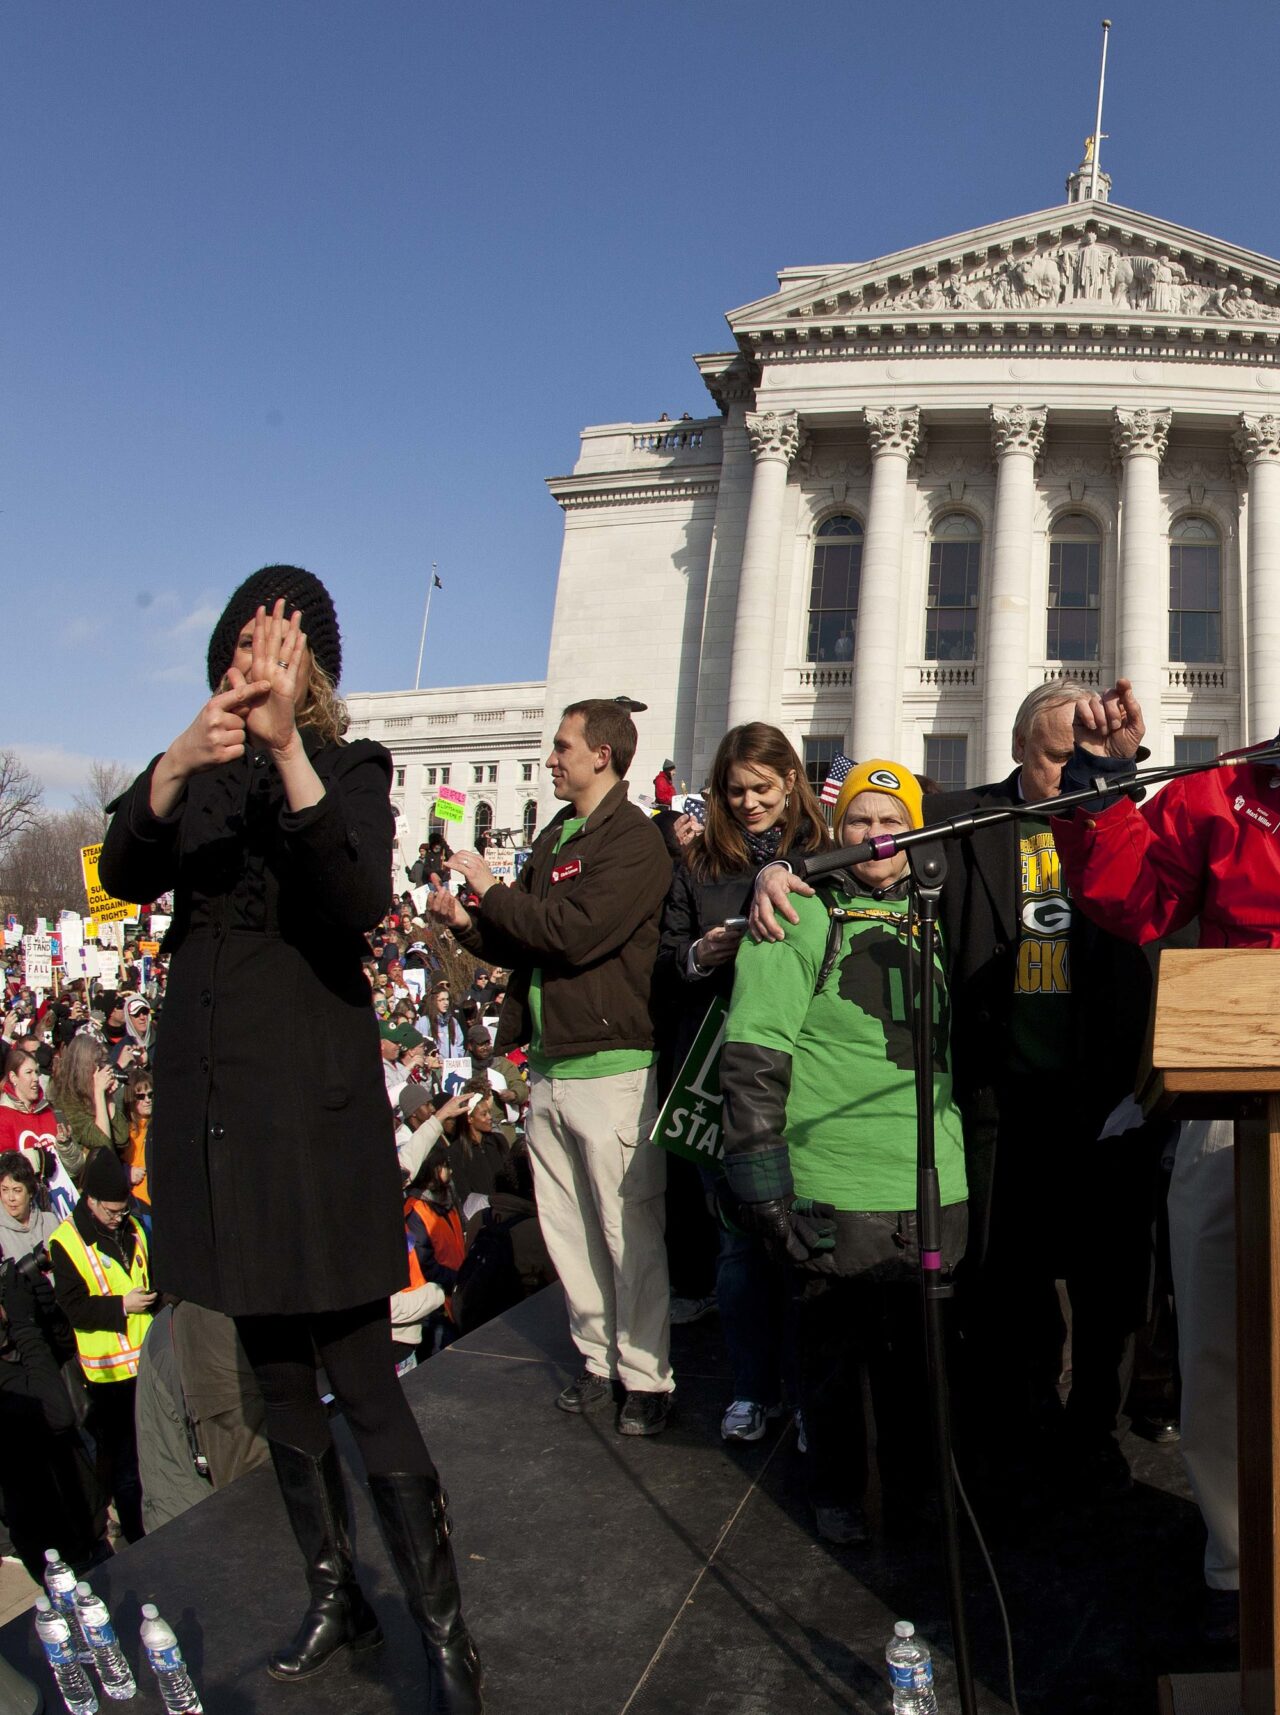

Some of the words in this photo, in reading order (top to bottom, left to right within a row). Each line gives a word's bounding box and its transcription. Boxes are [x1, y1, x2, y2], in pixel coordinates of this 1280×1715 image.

[1246, 808, 1259, 820] Mark
[1258, 815, 1272, 828] Miller
[101, 909, 128, 921] RIGHTS
[27, 944, 51, 952] STAND
[28, 965, 49, 974] FALL
